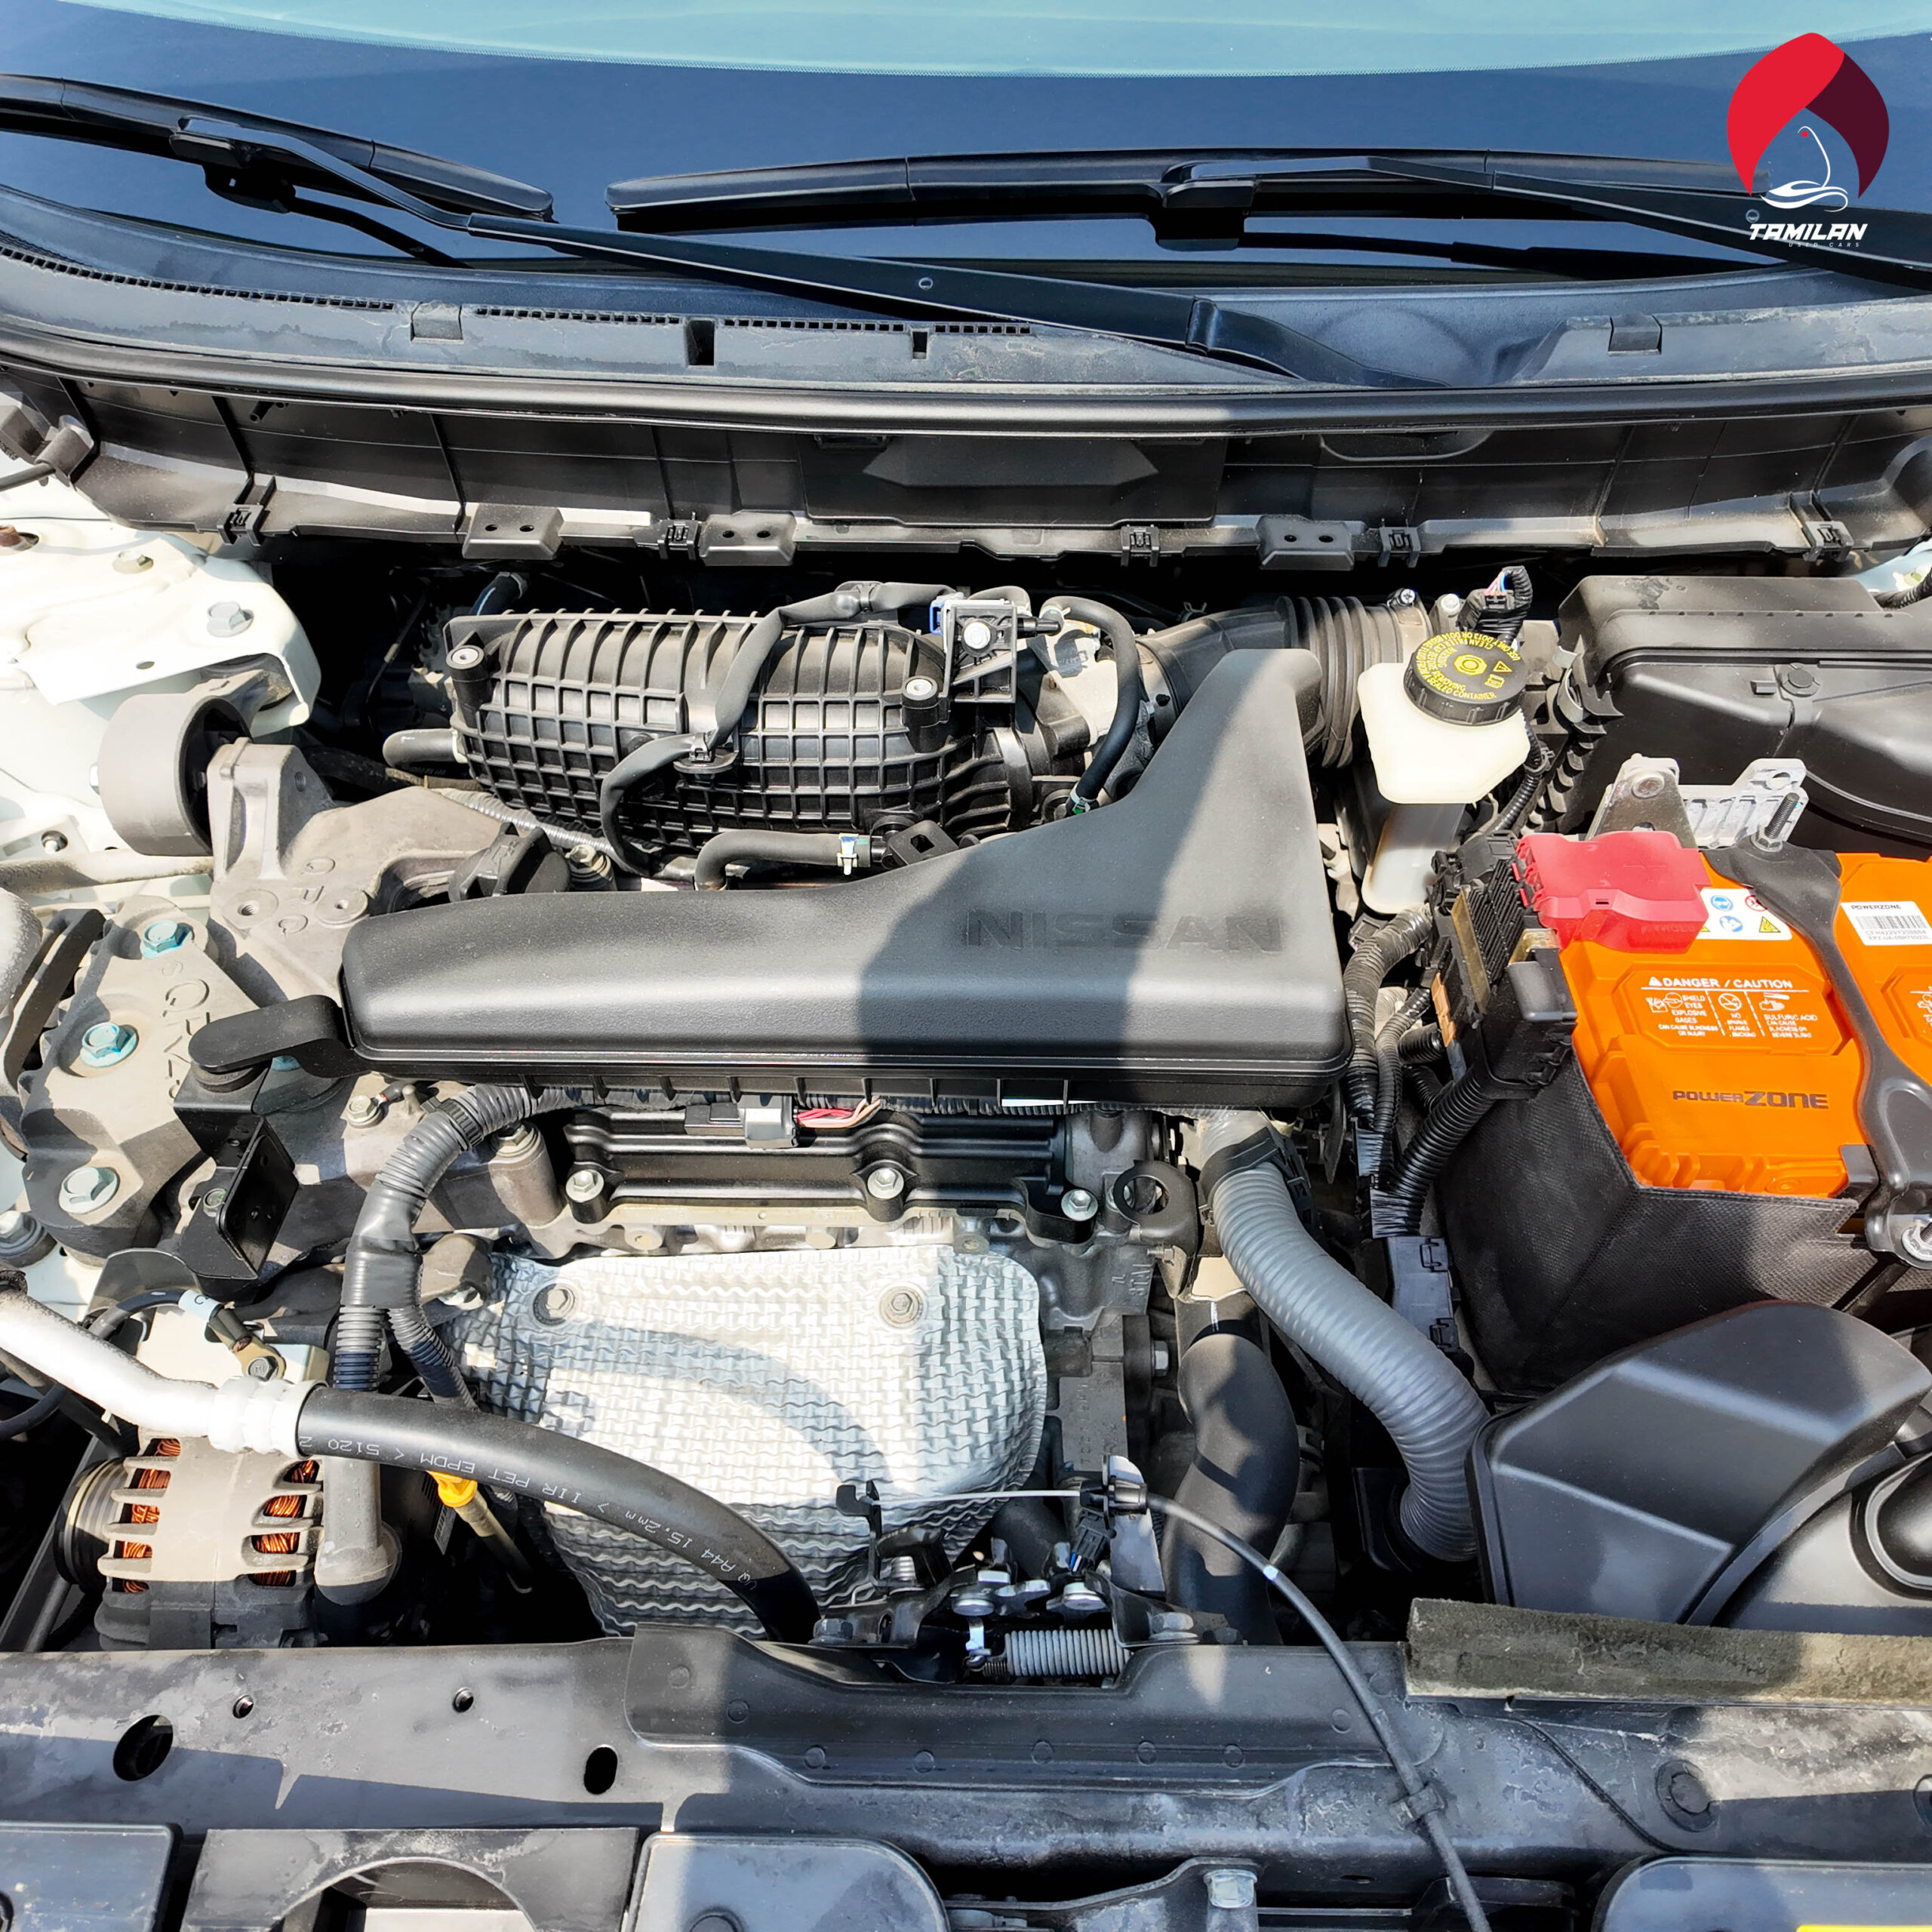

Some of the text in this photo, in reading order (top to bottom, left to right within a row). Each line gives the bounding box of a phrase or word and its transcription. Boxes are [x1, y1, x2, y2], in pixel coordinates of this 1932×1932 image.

[1469, 638, 1494, 650] CLEAN
[1474, 632, 1494, 644] DOT3
[1427, 678, 1453, 694] SEALED
[1453, 690, 1497, 700] CONTAINER
[964, 910, 1284, 953] NISSAN
[1663, 977, 1793, 989] DANGER / CAUTION
[328, 1438, 380, 1456] 5120
[420, 1452, 475, 1474] EPDM
[488, 1469, 531, 1488] PET
[542, 1482, 581, 1503] IIR
[625, 1510, 693, 1548] 15.2mm
[701, 1549, 736, 1572] A44
